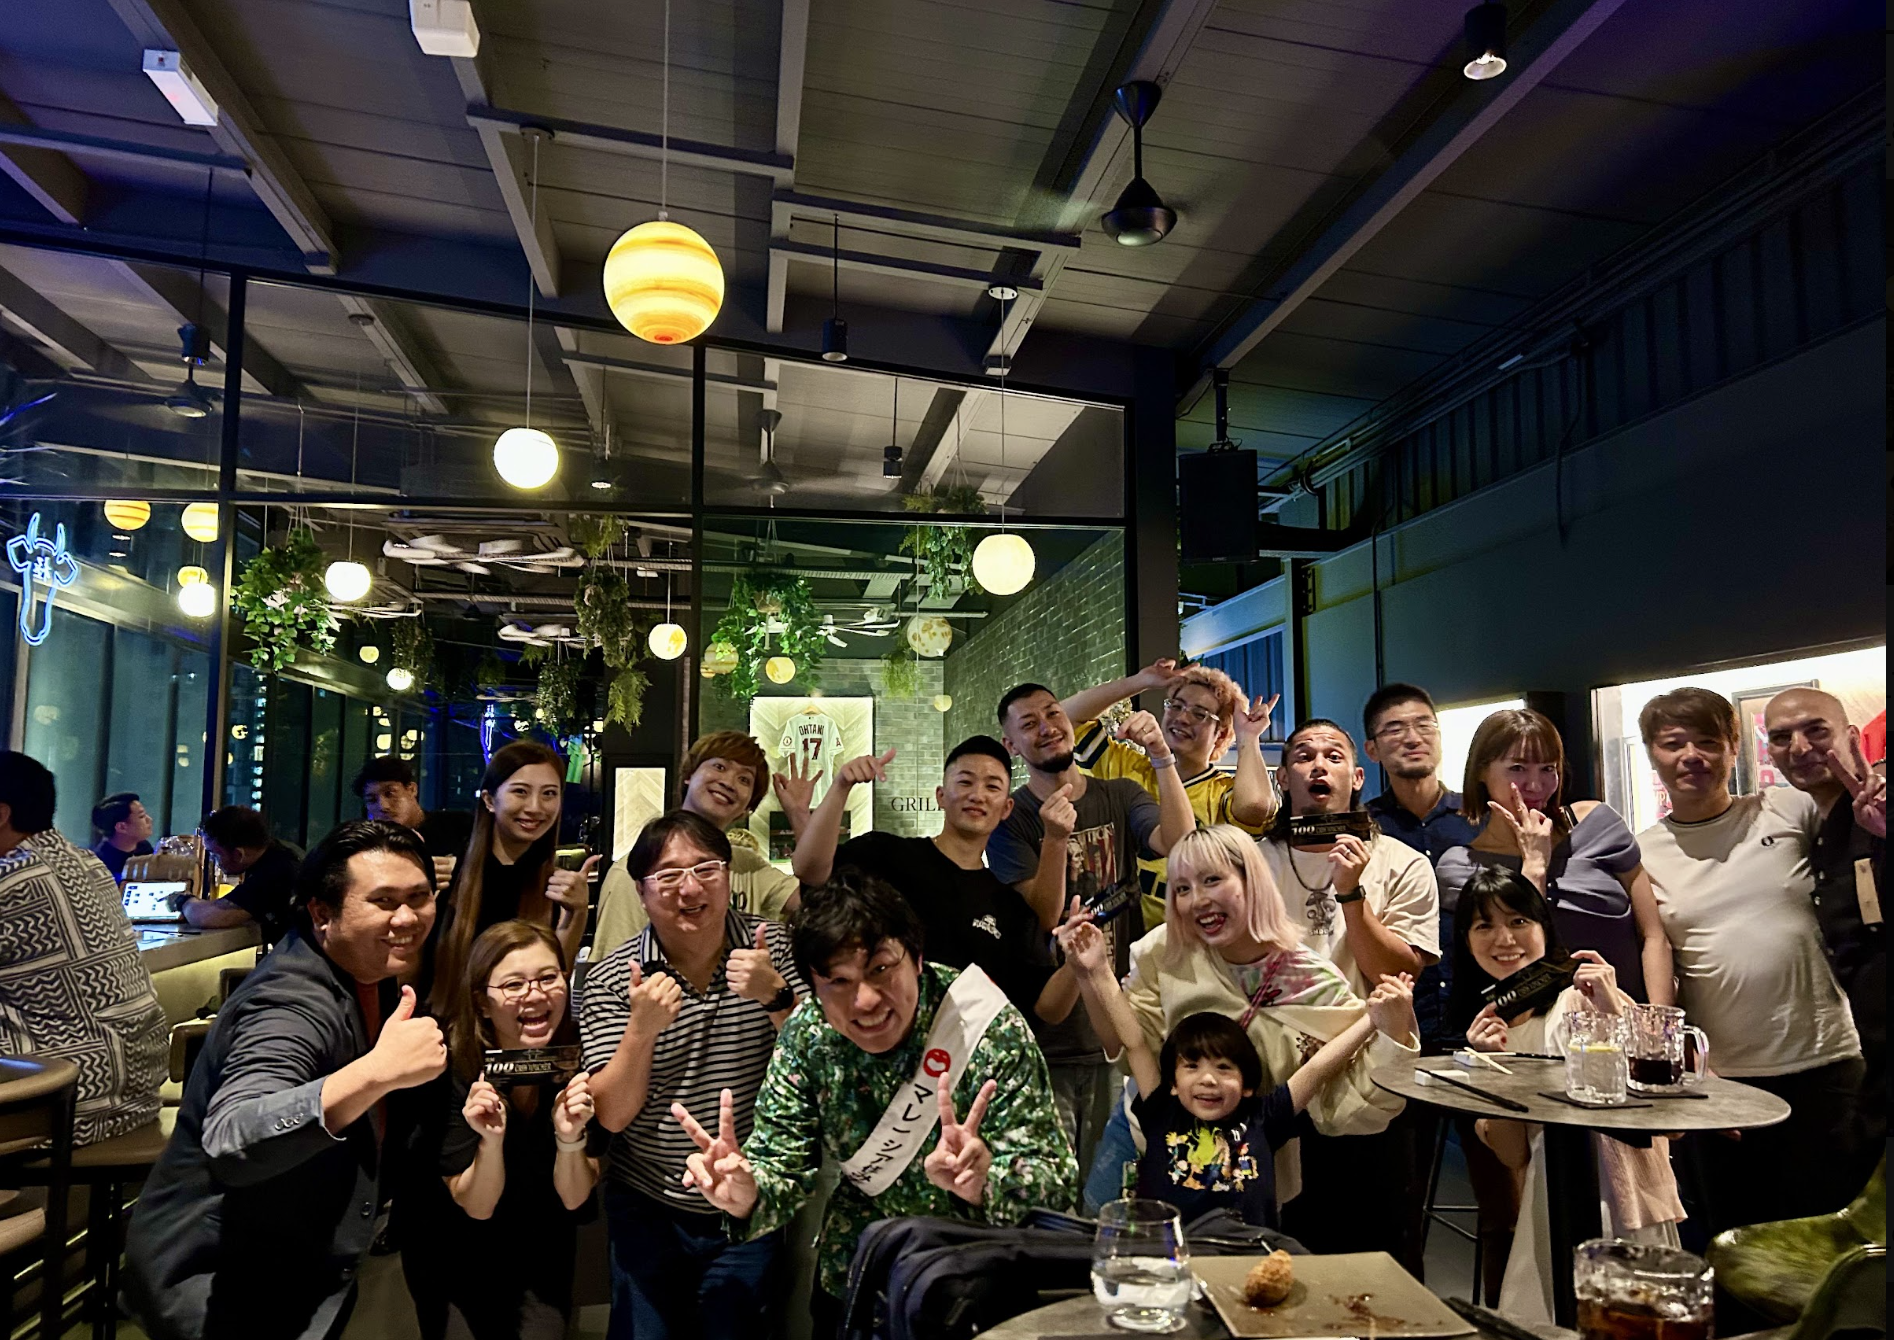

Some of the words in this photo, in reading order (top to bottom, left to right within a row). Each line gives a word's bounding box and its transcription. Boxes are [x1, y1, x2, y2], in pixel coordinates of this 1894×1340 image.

[798, 723, 825, 736] OHTANI
[802, 737, 822, 760] 17
[891, 796, 942, 812] GRIL
[1291, 825, 1315, 836] 100
[485, 1062, 515, 1074] 100
